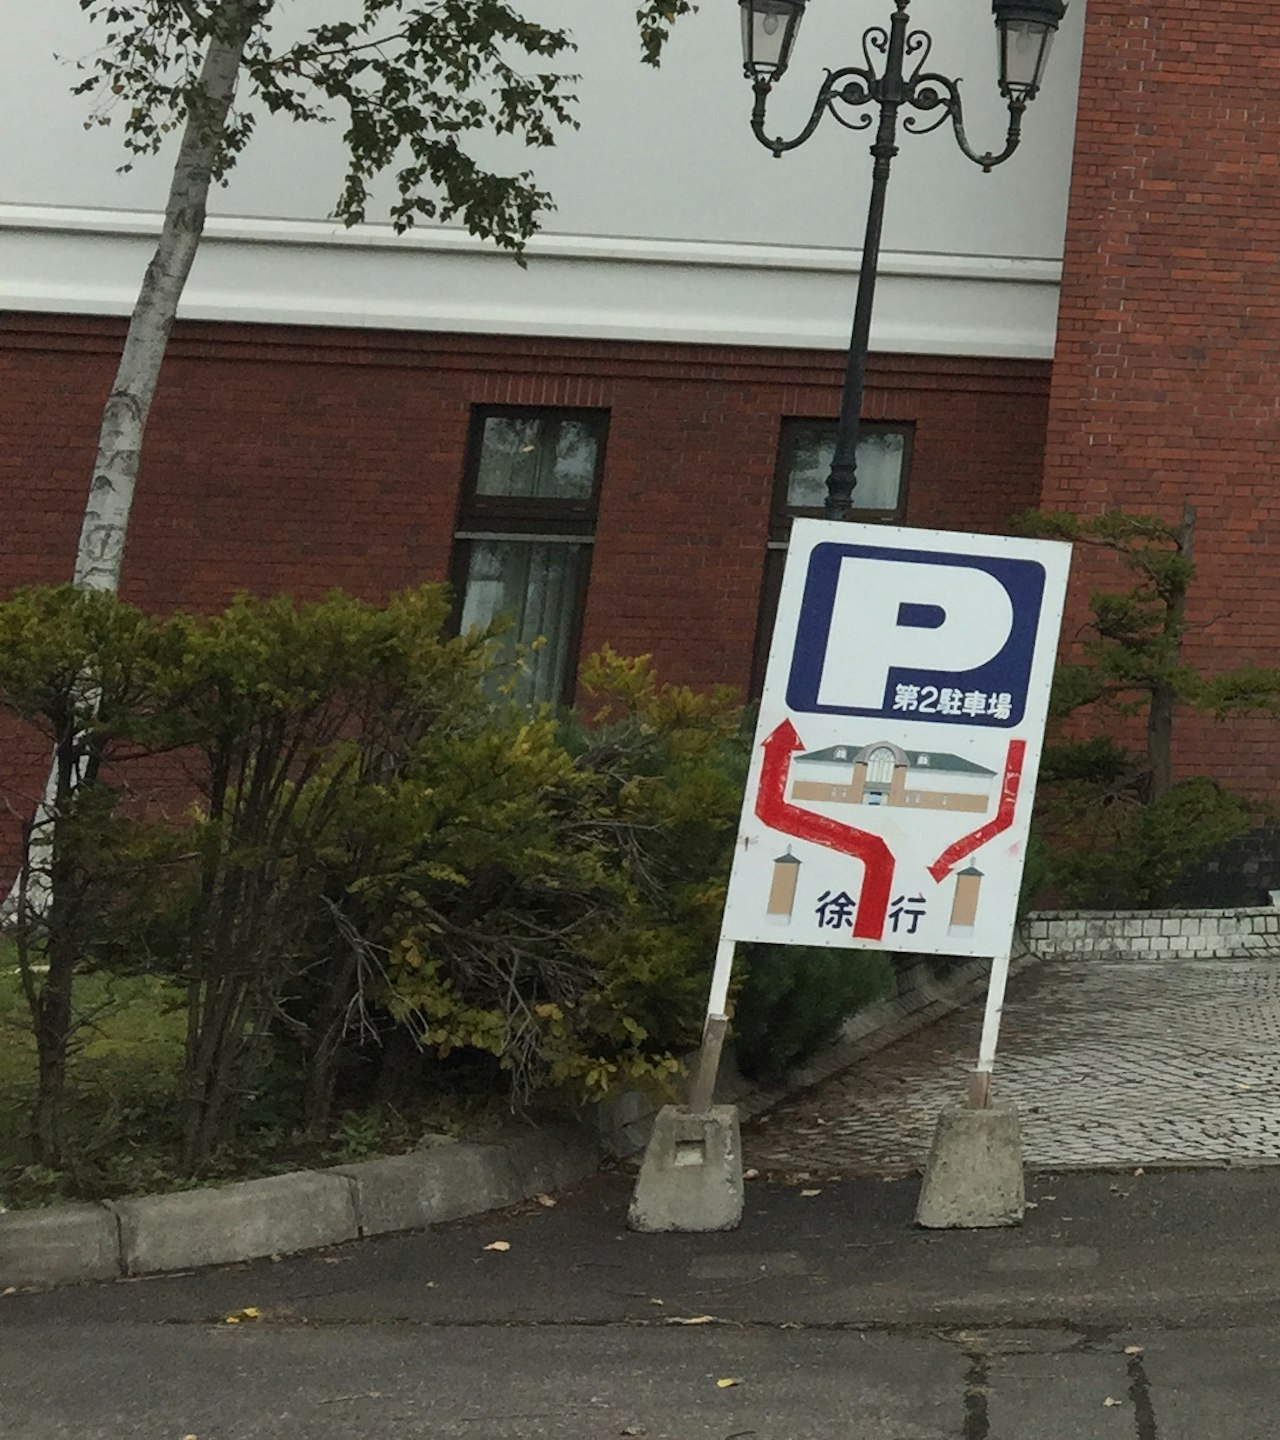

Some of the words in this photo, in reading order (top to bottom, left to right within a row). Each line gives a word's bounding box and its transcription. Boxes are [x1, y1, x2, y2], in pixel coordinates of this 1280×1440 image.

[817, 556, 1013, 710] P
[893, 683, 1013, 720] 第2駐車場
